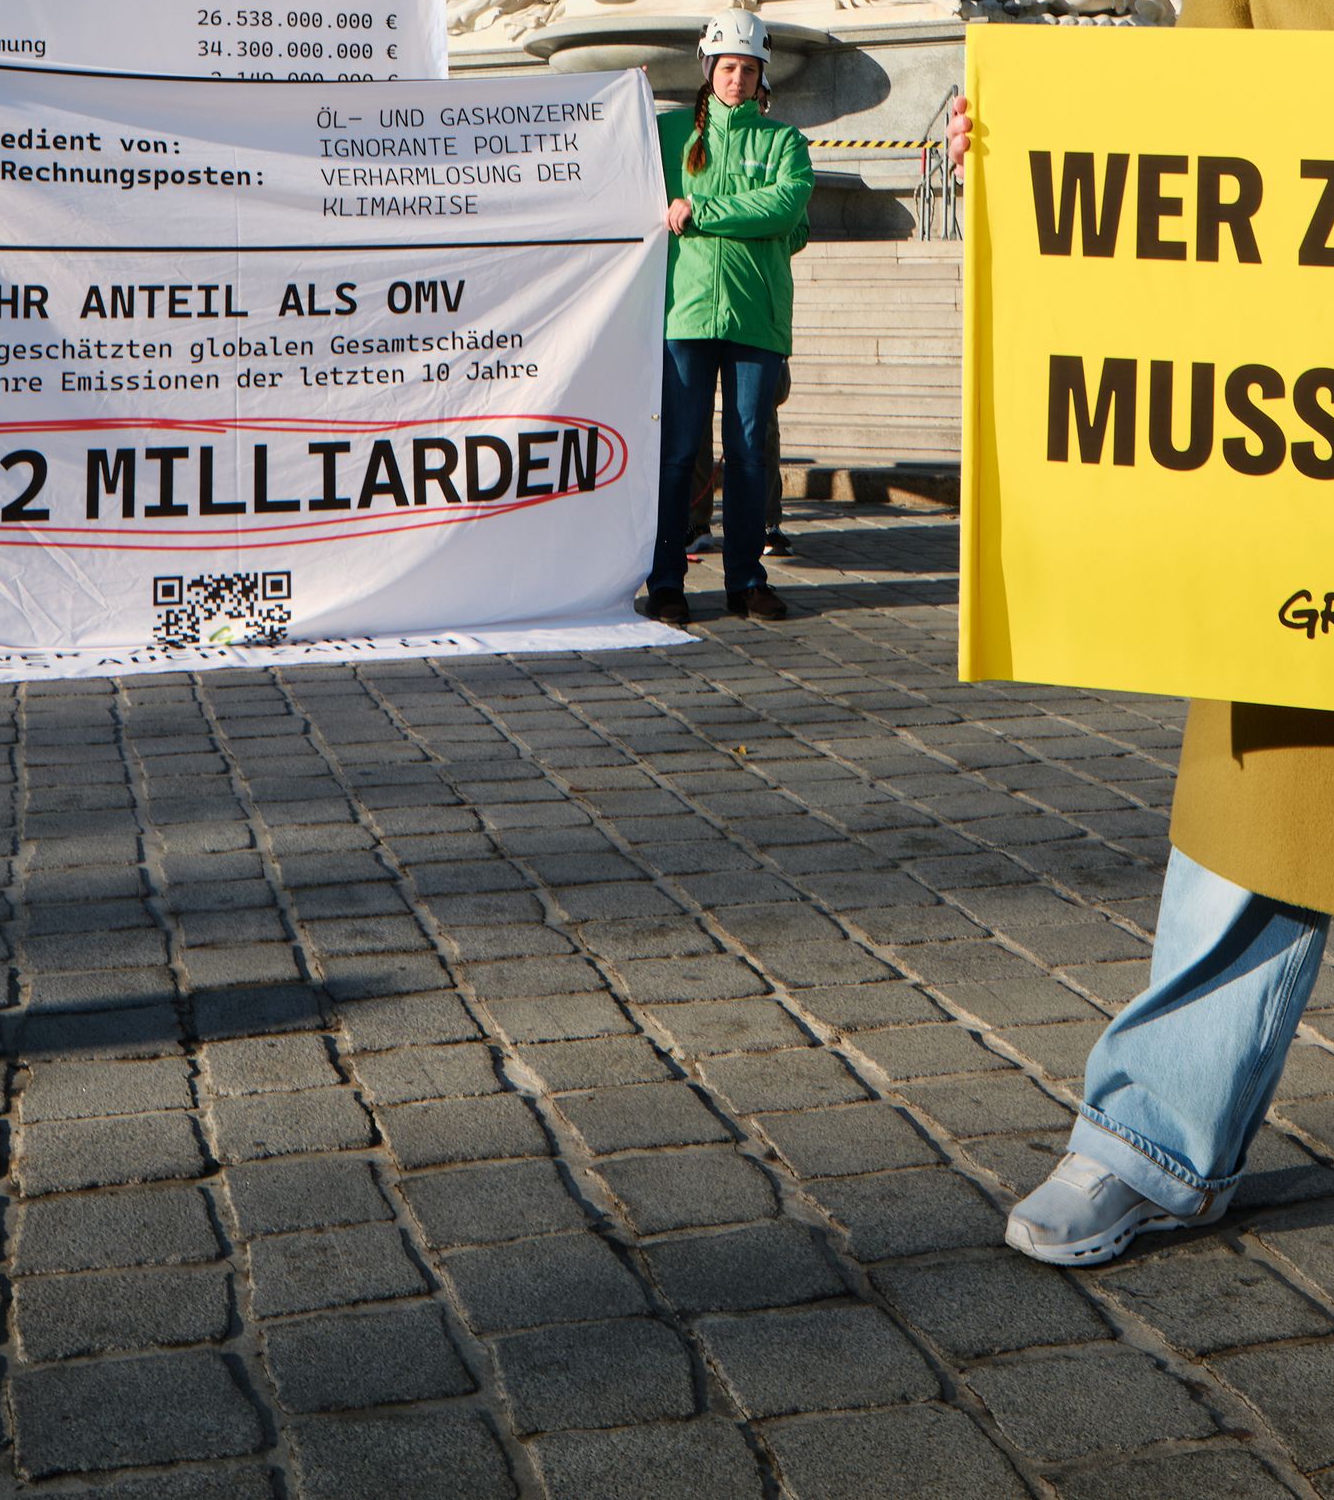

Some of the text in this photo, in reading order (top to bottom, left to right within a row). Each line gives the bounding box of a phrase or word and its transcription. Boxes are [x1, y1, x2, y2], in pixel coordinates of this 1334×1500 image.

[197, 9, 397, 30] 26.538.000.000 €
[198, 40, 398, 60] 34.300.000.000 €
[317, 102, 604, 128] ÖL- UND GASKONZERNE
[119, 138, 180, 155] von:
[320, 133, 578, 157] IGNORANTE POLITIK
[1, 160, 263, 191] Rechnungsposten:
[321, 162, 581, 186] VERHARMLOSUNG DER
[323, 195, 478, 216] KLIMAKRISE
[1029, 151, 1262, 263] WER
[80, 284, 248, 319] ANTEIL
[279, 282, 357, 317] ALS
[387, 280, 465, 314] OMV
[190, 336, 313, 364] globalen
[331, 329, 523, 354] Gesamtschäden
[62, 372, 219, 391] Emissionen
[237, 368, 283, 388] der
[300, 366, 404, 386] letzten
[422, 363, 450, 382] 10
[466, 359, 538, 381] Jahre
[87, 427, 598, 518] MILLIARDEN
